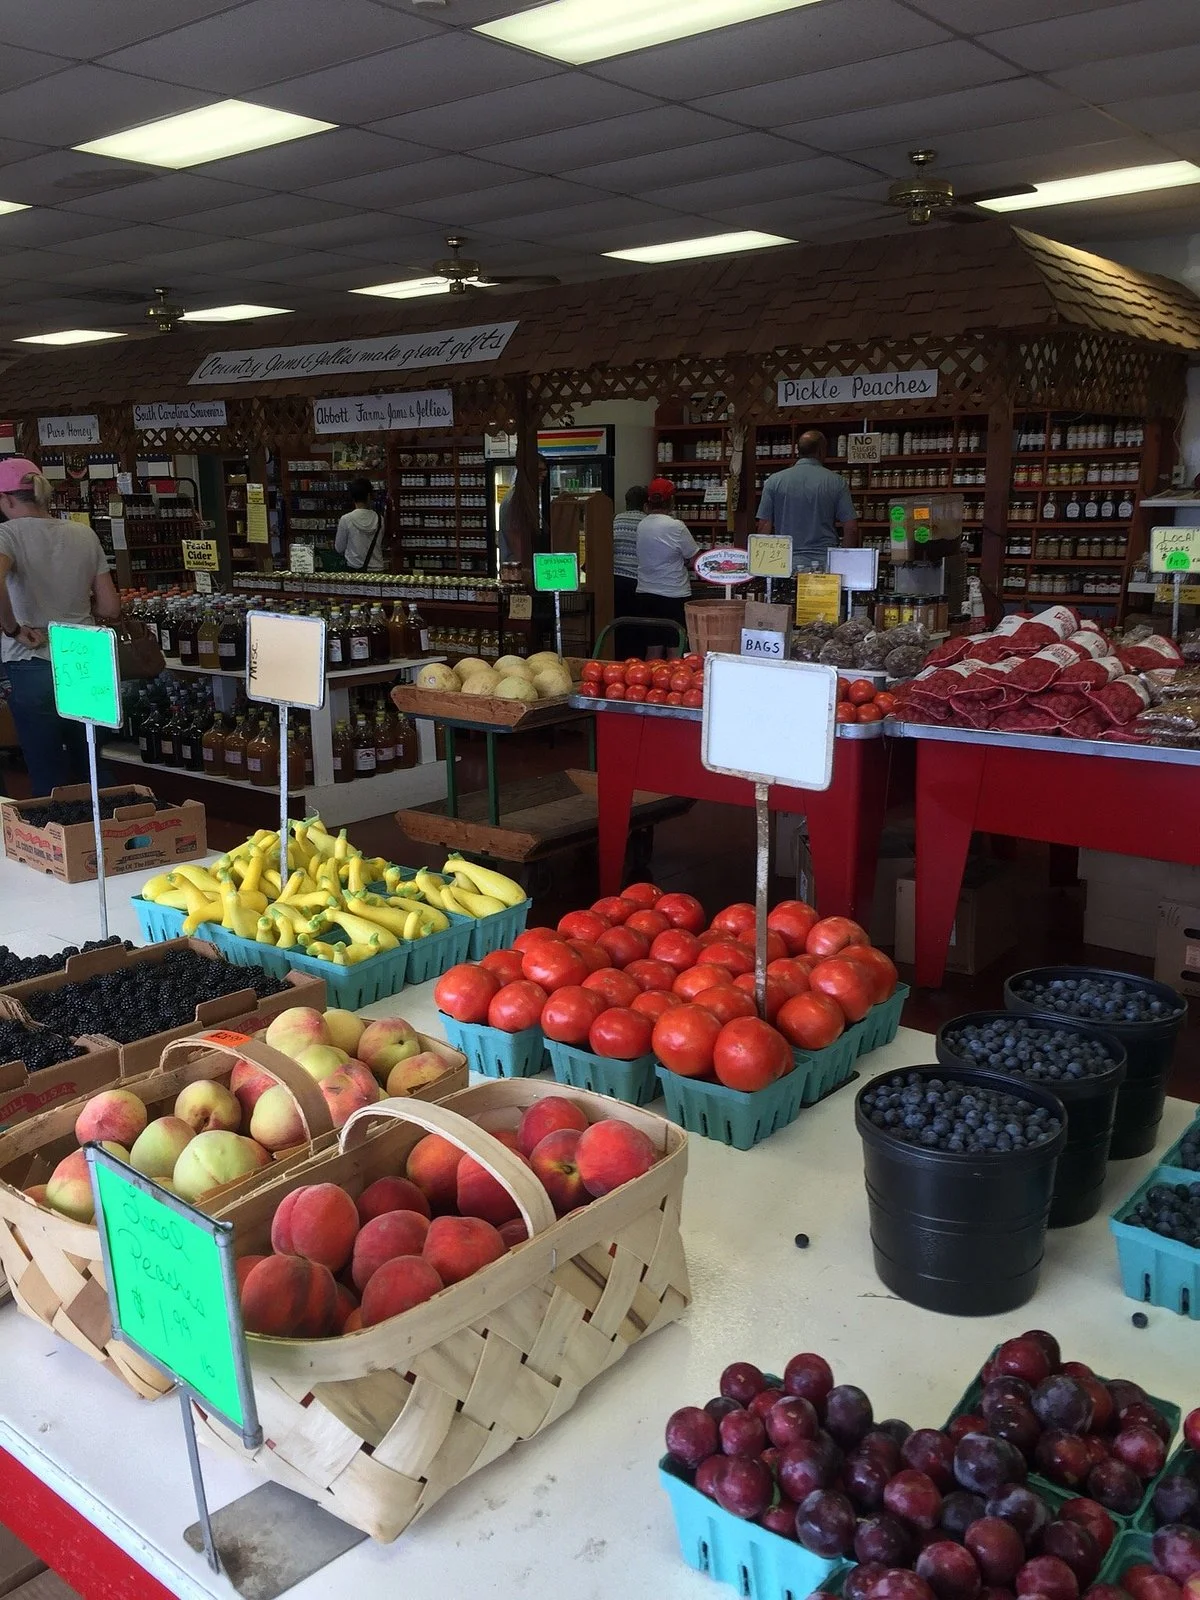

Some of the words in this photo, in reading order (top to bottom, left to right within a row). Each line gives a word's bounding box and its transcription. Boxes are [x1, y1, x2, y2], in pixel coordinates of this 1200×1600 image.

[199, 356, 265, 380] Country
[260, 354, 301, 378] Jams
[306, 347, 358, 373] Jellies
[359, 344, 400, 362] make
[398, 336, 454, 366] great
[446, 329, 505, 362] gifts
[784, 379, 840, 402] Pickle
[853, 374, 931, 398] Peaches
[135, 403, 157, 421] South
[158, 403, 189, 420] Carolina
[316, 406, 350, 424] Abbott
[355, 402, 385, 422] Farms
[387, 402, 407, 428] Jams
[416, 399, 451, 427] Jellies
[47, 422, 65, 439] Pure
[67, 421, 93, 441] Honey
[854, 436, 873, 445] NO
[186, 541, 212, 550] Peach
[187, 551, 212, 560] Cider
[746, 638, 780, 653] BAGS
